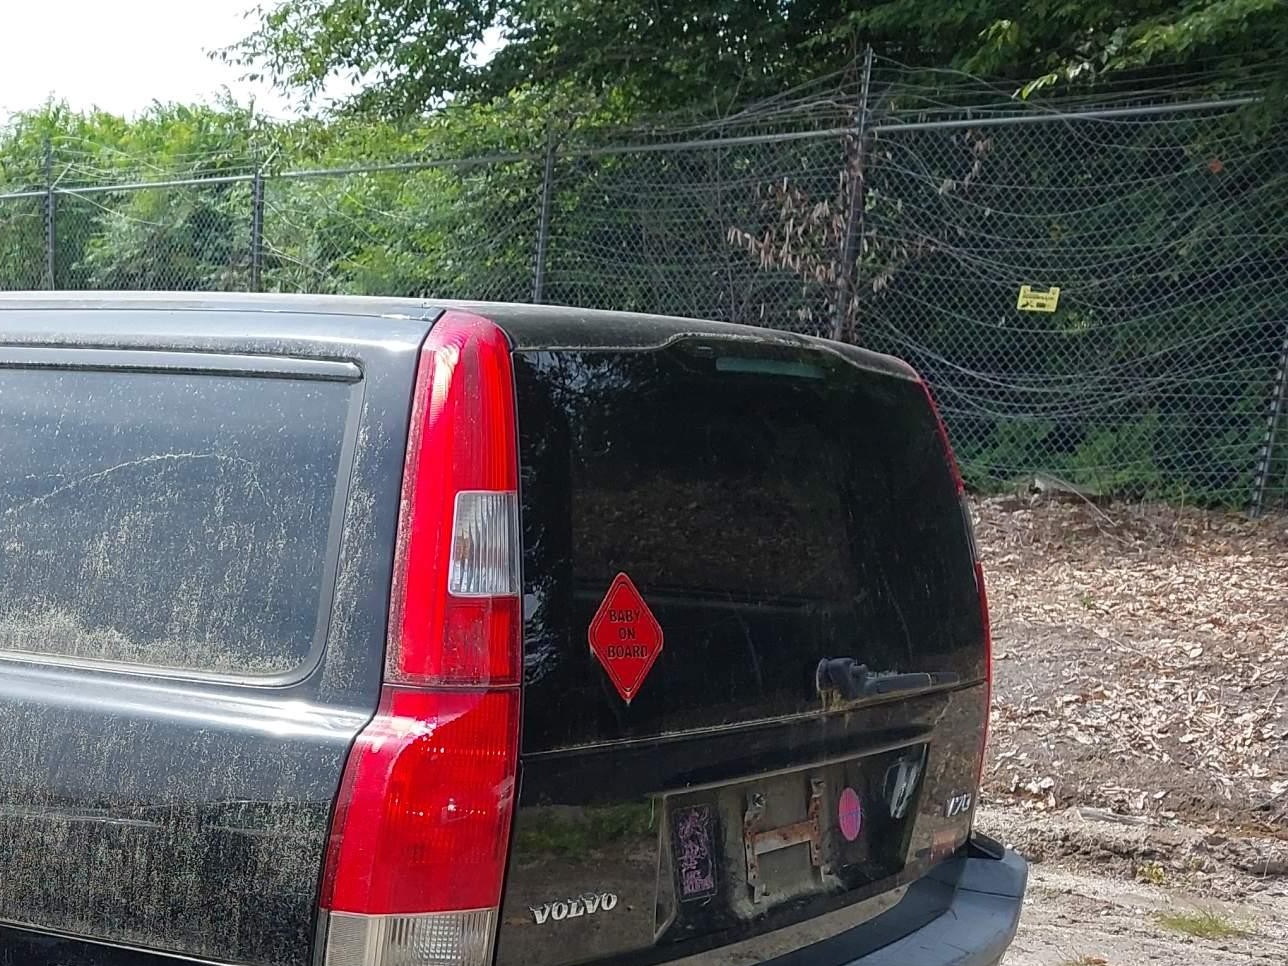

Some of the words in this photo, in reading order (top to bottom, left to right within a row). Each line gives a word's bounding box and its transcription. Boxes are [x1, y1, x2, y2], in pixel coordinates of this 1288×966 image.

[609, 609, 640, 622] BABY
[618, 627, 636, 639] ON
[607, 645, 648, 658] BOARD
[528, 893, 618, 924] VOLVO
